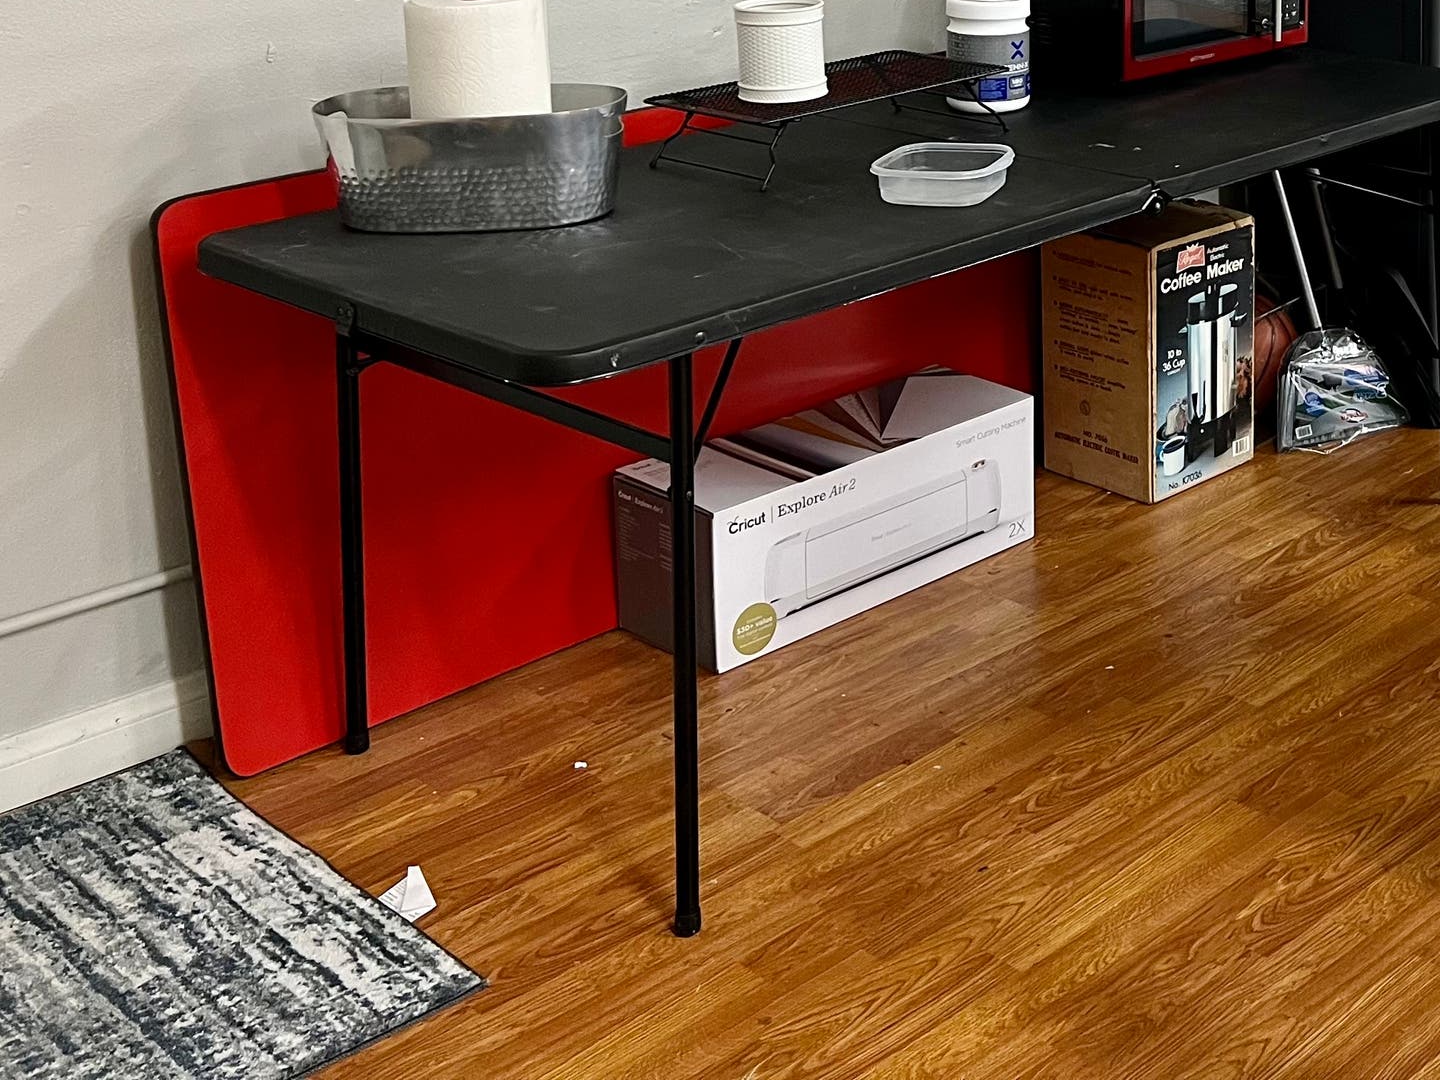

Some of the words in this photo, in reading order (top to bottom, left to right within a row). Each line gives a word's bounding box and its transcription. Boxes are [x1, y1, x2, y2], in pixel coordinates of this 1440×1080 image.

[1160, 271, 1202, 294] Coffee
[1206, 258, 1245, 280] Maker
[955, 434, 976, 449] Smart
[977, 426, 1000, 440] Cutting
[1001, 416, 1026, 431] Machine
[727, 511, 766, 534] Cricut
[777, 492, 827, 518] Explore
